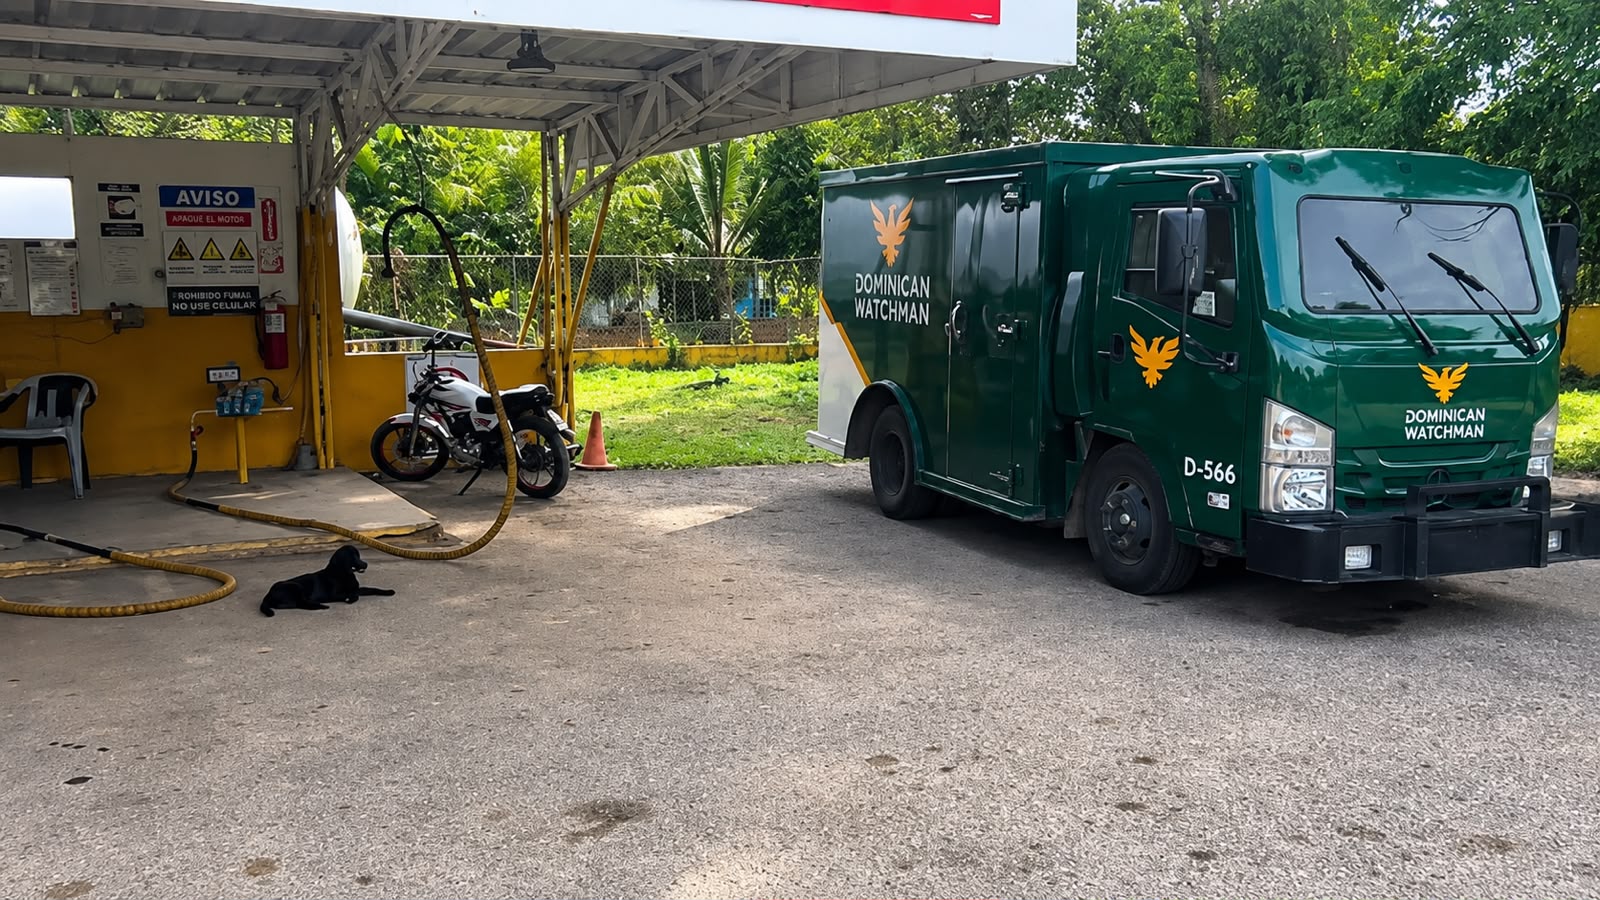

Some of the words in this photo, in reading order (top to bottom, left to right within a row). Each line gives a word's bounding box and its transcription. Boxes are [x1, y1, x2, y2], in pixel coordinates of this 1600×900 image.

[176, 190, 240, 206] AVISO
[172, 215, 204, 223] APAGUE
[206, 215, 216, 223] EL
[218, 215, 245, 223] MOTOR
[855, 273, 930, 299] DOMINICAN
[172, 291, 221, 300] ROHIBIDO
[172, 302, 188, 310] NO
[190, 302, 210, 310] USE
[854, 297, 930, 326] WATCHMAN
[1405, 407, 1486, 424] DOMINICAN
[1404, 424, 1484, 440] WATCHMAN
[1184, 456, 1236, 485] D-566
